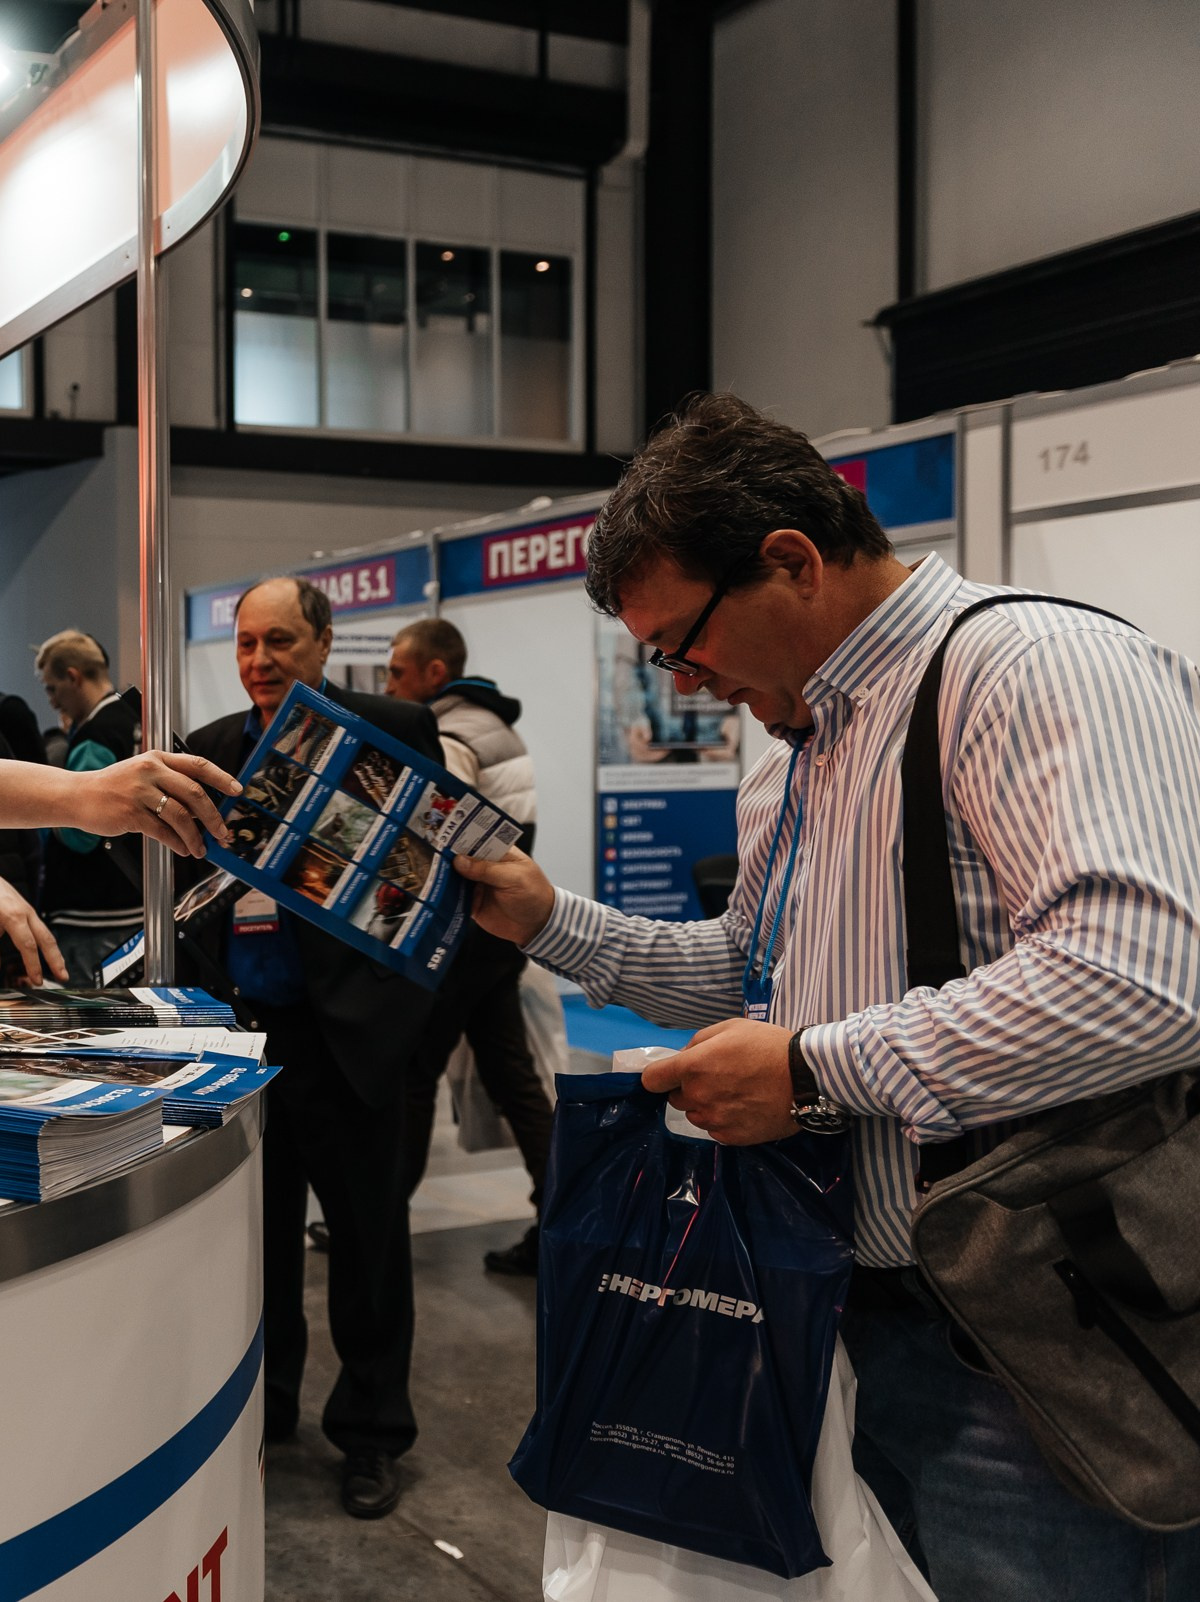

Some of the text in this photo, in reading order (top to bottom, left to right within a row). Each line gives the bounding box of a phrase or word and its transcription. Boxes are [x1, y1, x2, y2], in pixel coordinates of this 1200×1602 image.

[1039, 441, 1090, 474] 174
[357, 566, 391, 602] 5.1
[427, 946, 447, 971] SDS
